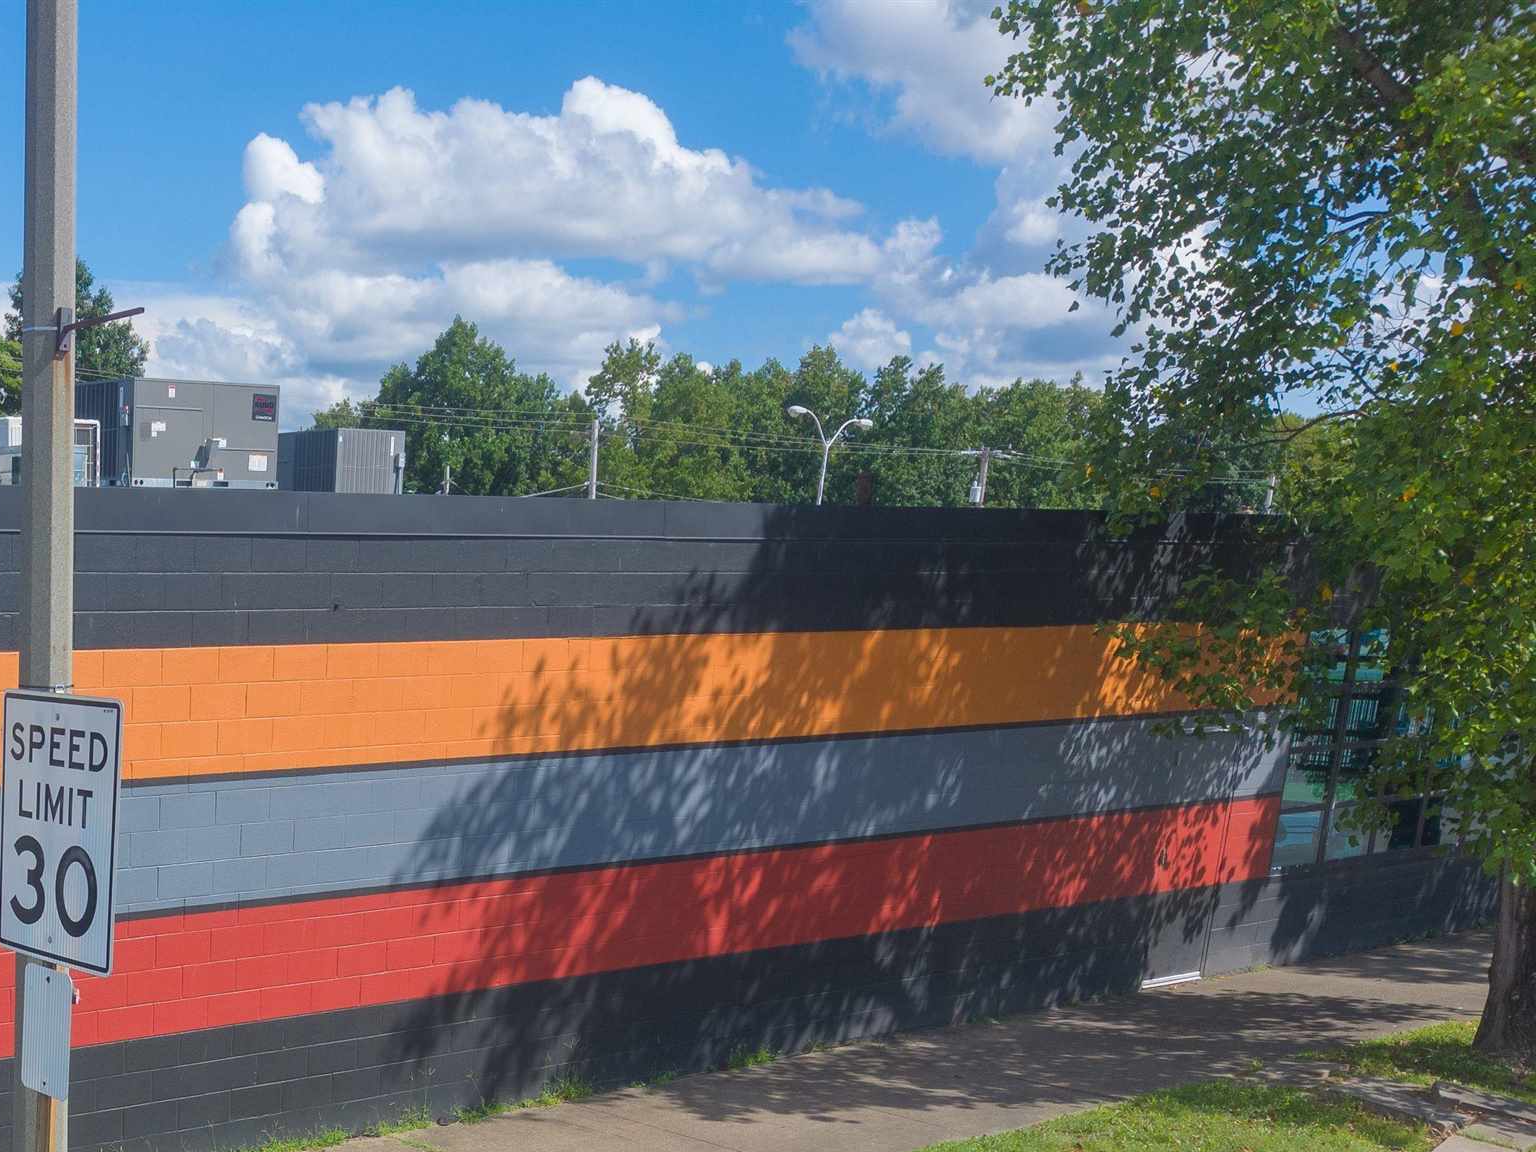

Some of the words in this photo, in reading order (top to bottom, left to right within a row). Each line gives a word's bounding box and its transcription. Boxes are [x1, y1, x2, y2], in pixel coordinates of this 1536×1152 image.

[10, 722, 109, 773] SPEED
[18, 779, 94, 830] LIMIT
[9, 834, 98, 938] 30
